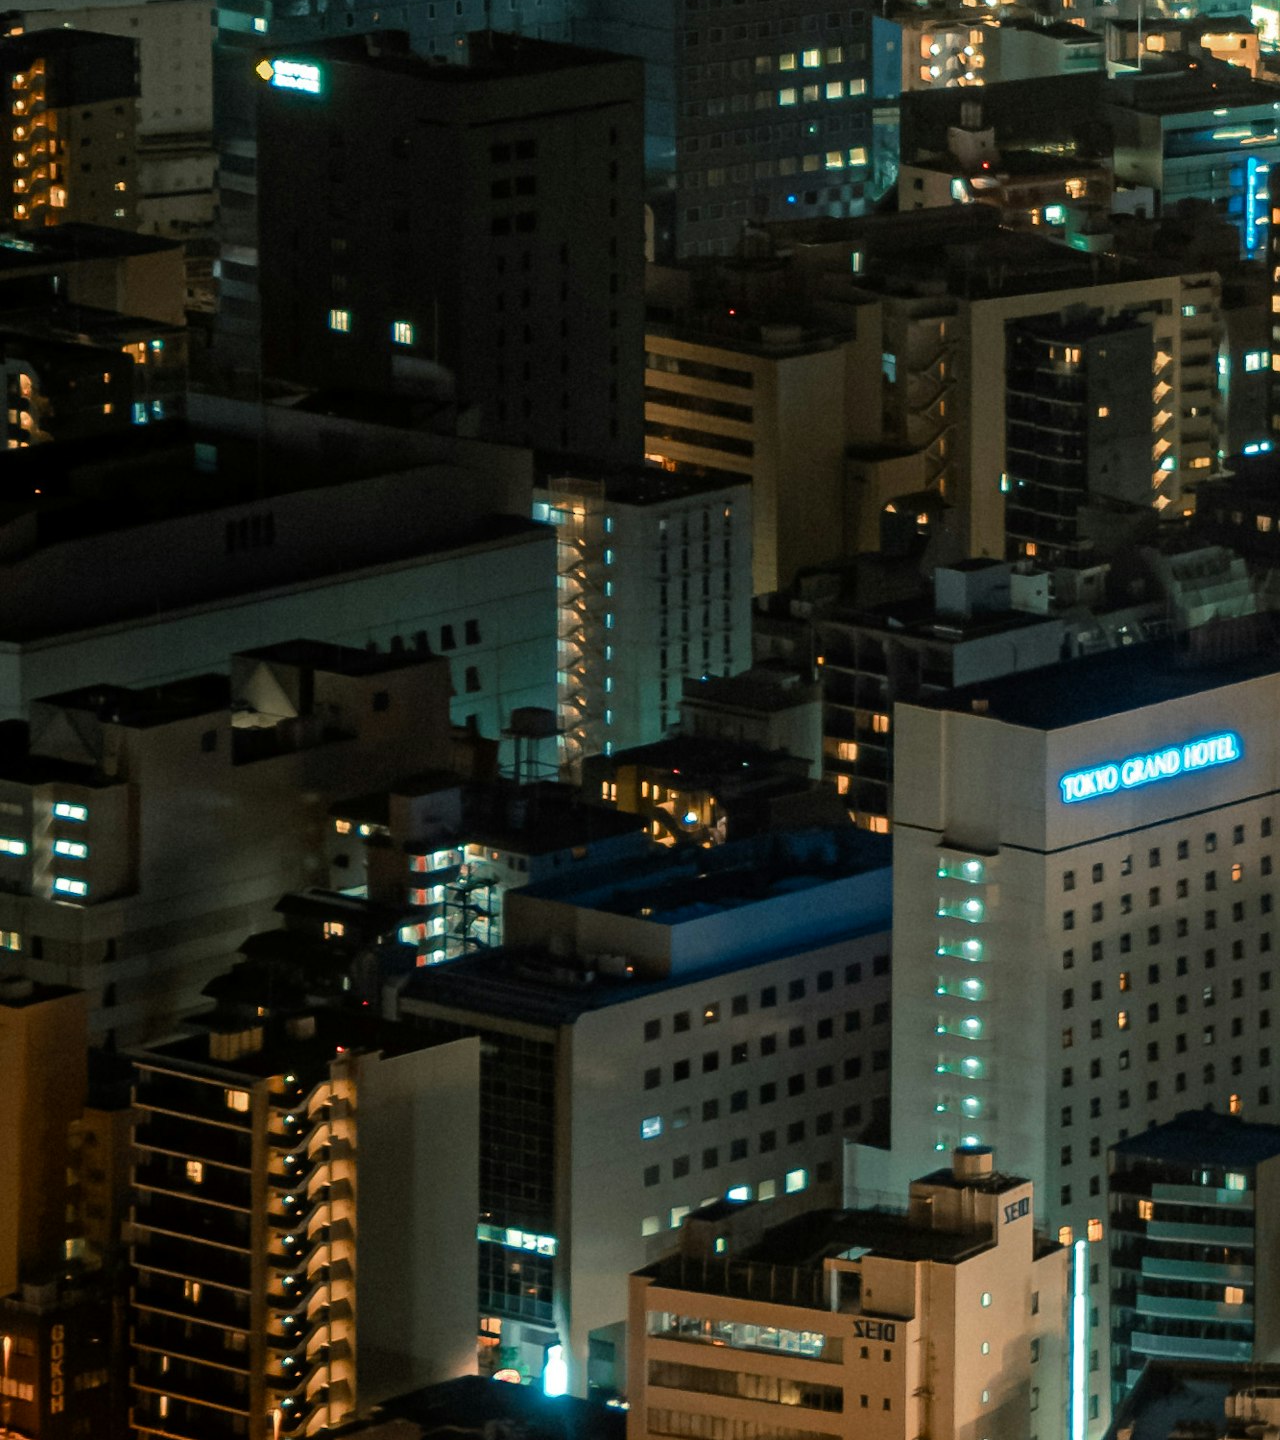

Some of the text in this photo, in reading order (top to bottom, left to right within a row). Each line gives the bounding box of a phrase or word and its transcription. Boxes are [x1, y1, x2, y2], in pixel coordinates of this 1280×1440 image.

[1061, 735, 1237, 801] TOKYO GRAND HOTEL
